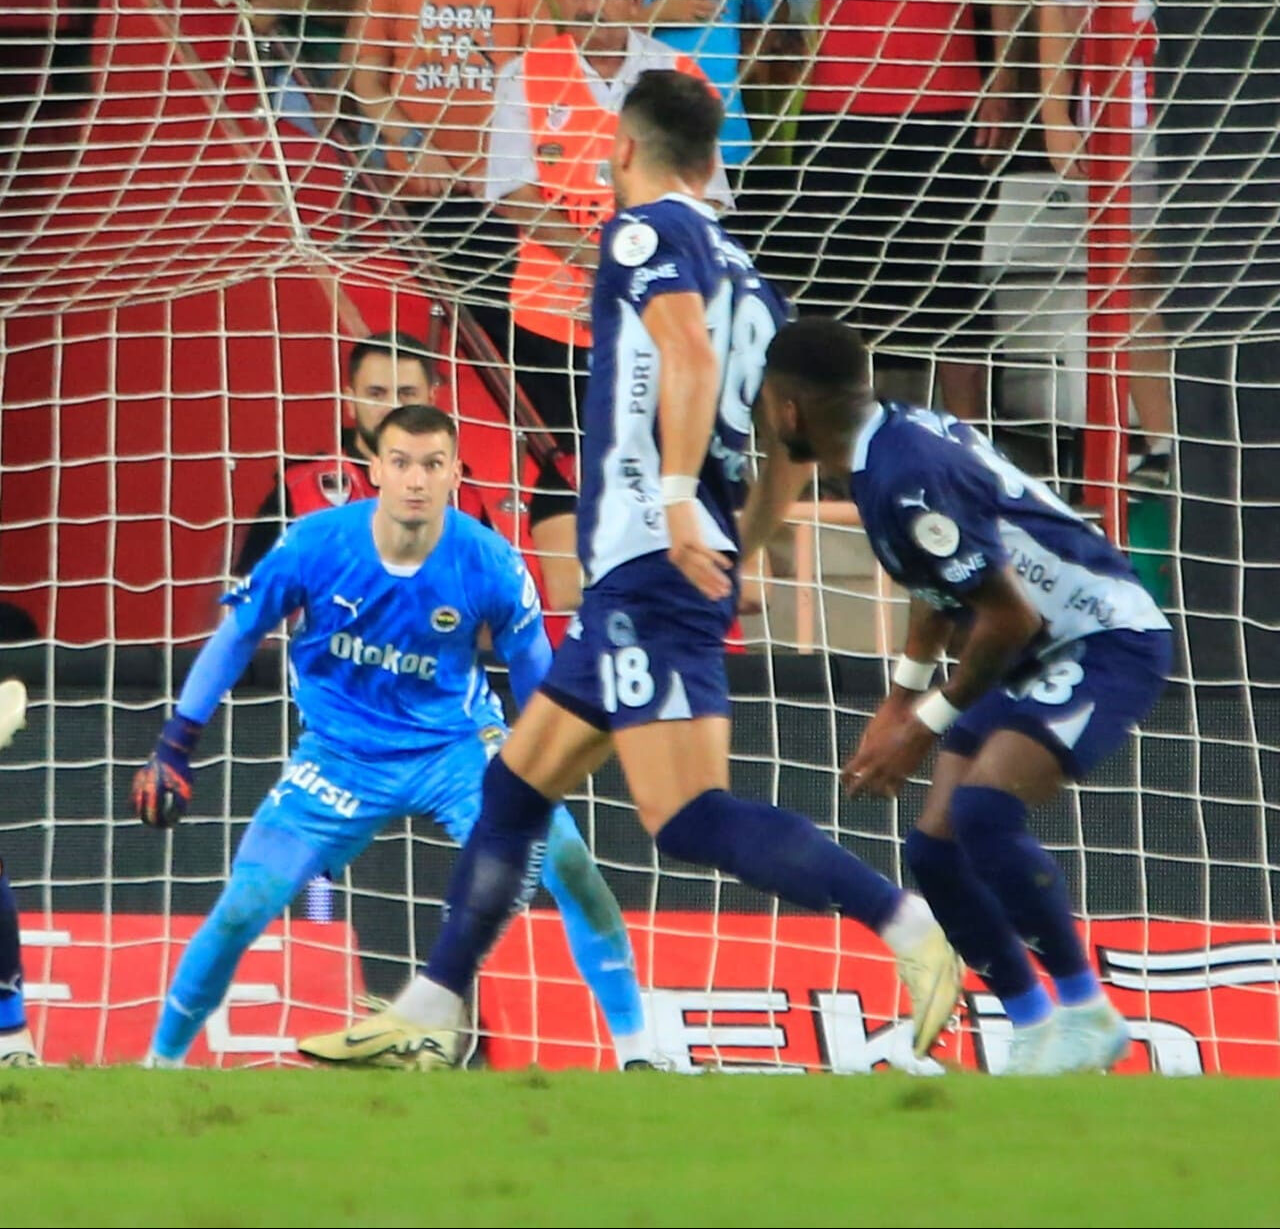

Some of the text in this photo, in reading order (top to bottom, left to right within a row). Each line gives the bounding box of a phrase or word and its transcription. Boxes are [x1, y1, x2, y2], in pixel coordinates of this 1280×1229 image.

[421, 4, 494, 30] BORN
[438, 34, 471, 60] TO
[415, 63, 496, 92] SKATE
[629, 348, 653, 415] PORT
[599, 647, 655, 712] 18
[282, 760, 361, 819] ürsu
